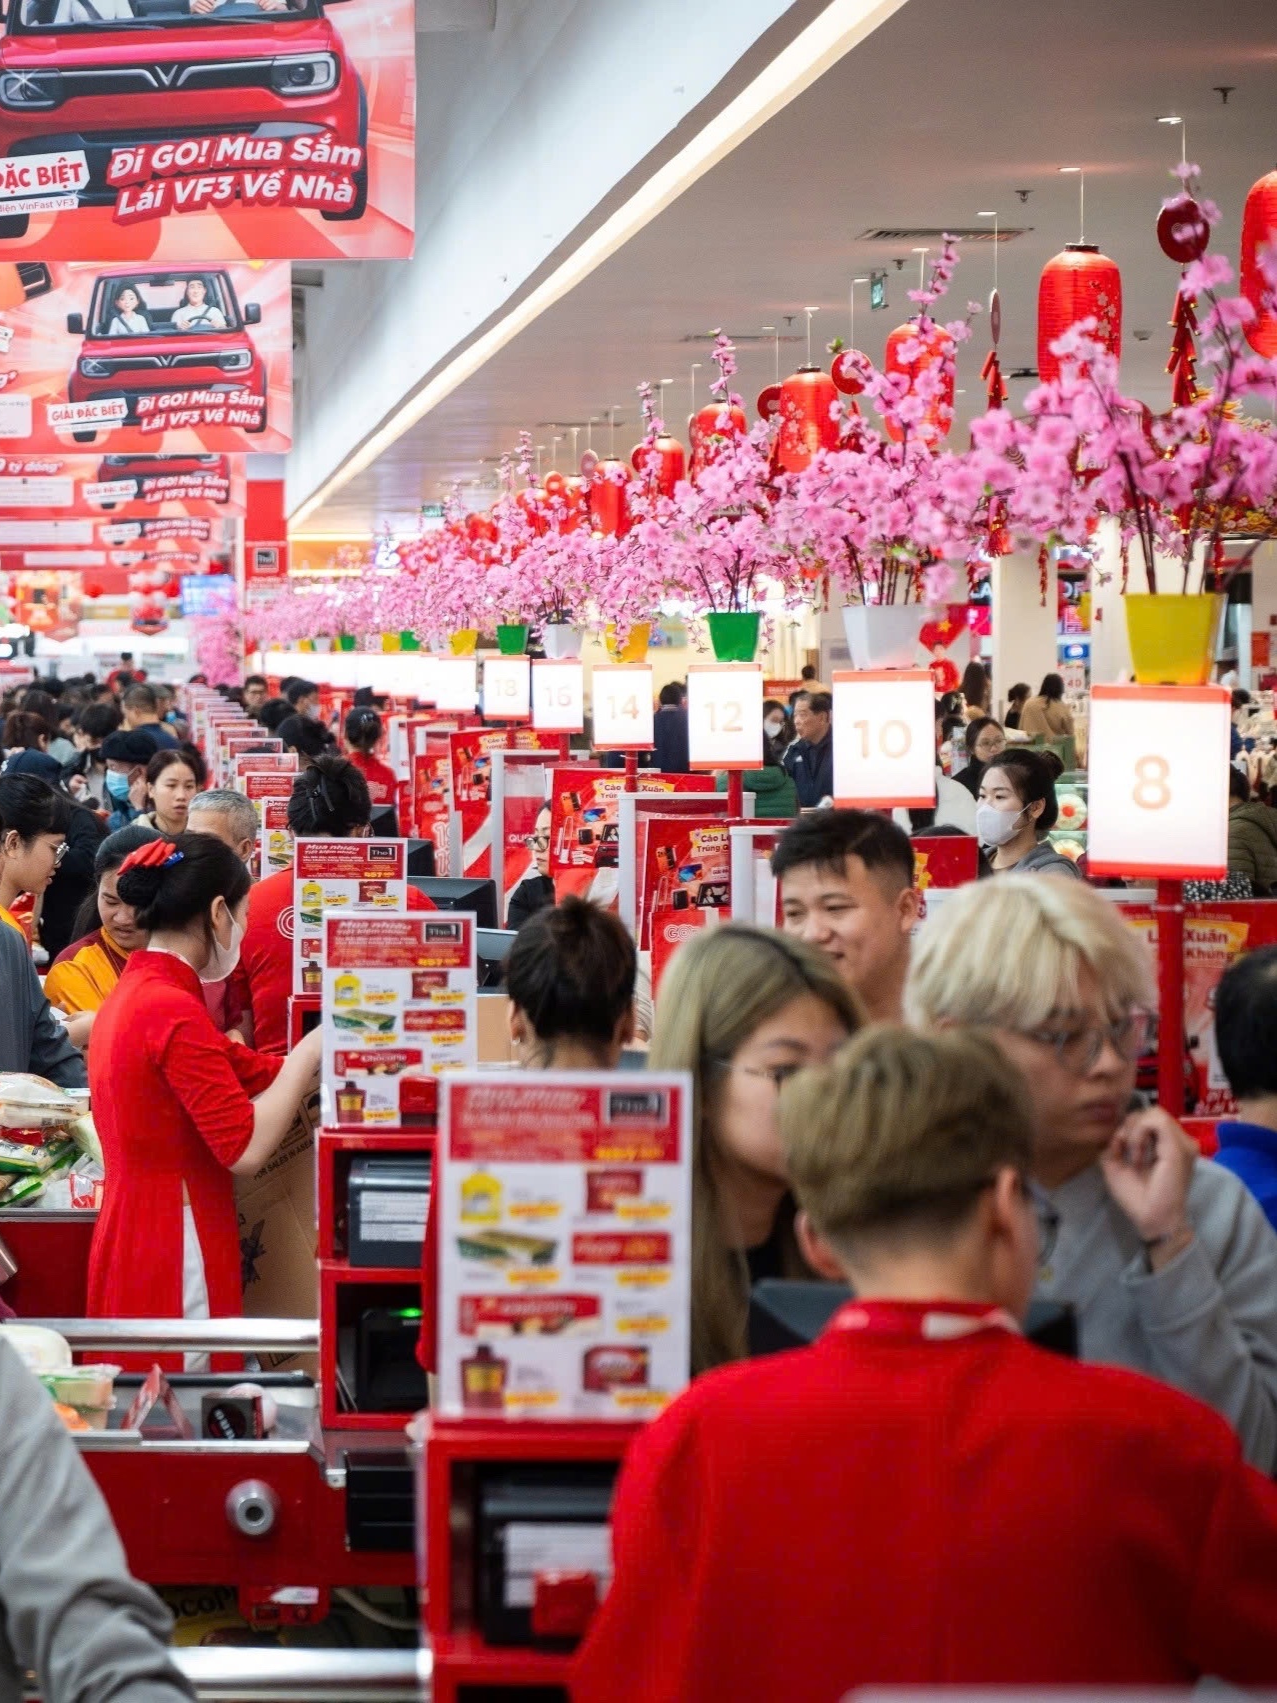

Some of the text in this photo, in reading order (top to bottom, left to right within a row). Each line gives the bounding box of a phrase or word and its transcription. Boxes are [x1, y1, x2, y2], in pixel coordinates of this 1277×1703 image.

[110, 131, 362, 179] Đi GO! Mua Sắm
[37, 156, 84, 190] BIỆT
[18, 200, 55, 213] VinFast
[56, 199, 75, 209] VF3
[117, 167, 355, 219] Lái VF3 Về Nhà
[52, 402, 124, 421] GIẢI ĐẶC BIỆT
[138, 388, 265, 412] Đi GO! Mua Sắm
[141, 413, 165, 431] Lái
[169, 411, 198, 426] VF3
[226, 408, 261, 425] Nhà
[607, 694, 639, 720] 14
[703, 700, 744, 732] 12
[852, 719, 913, 759] 10
[1132, 754, 1173, 810] 8
